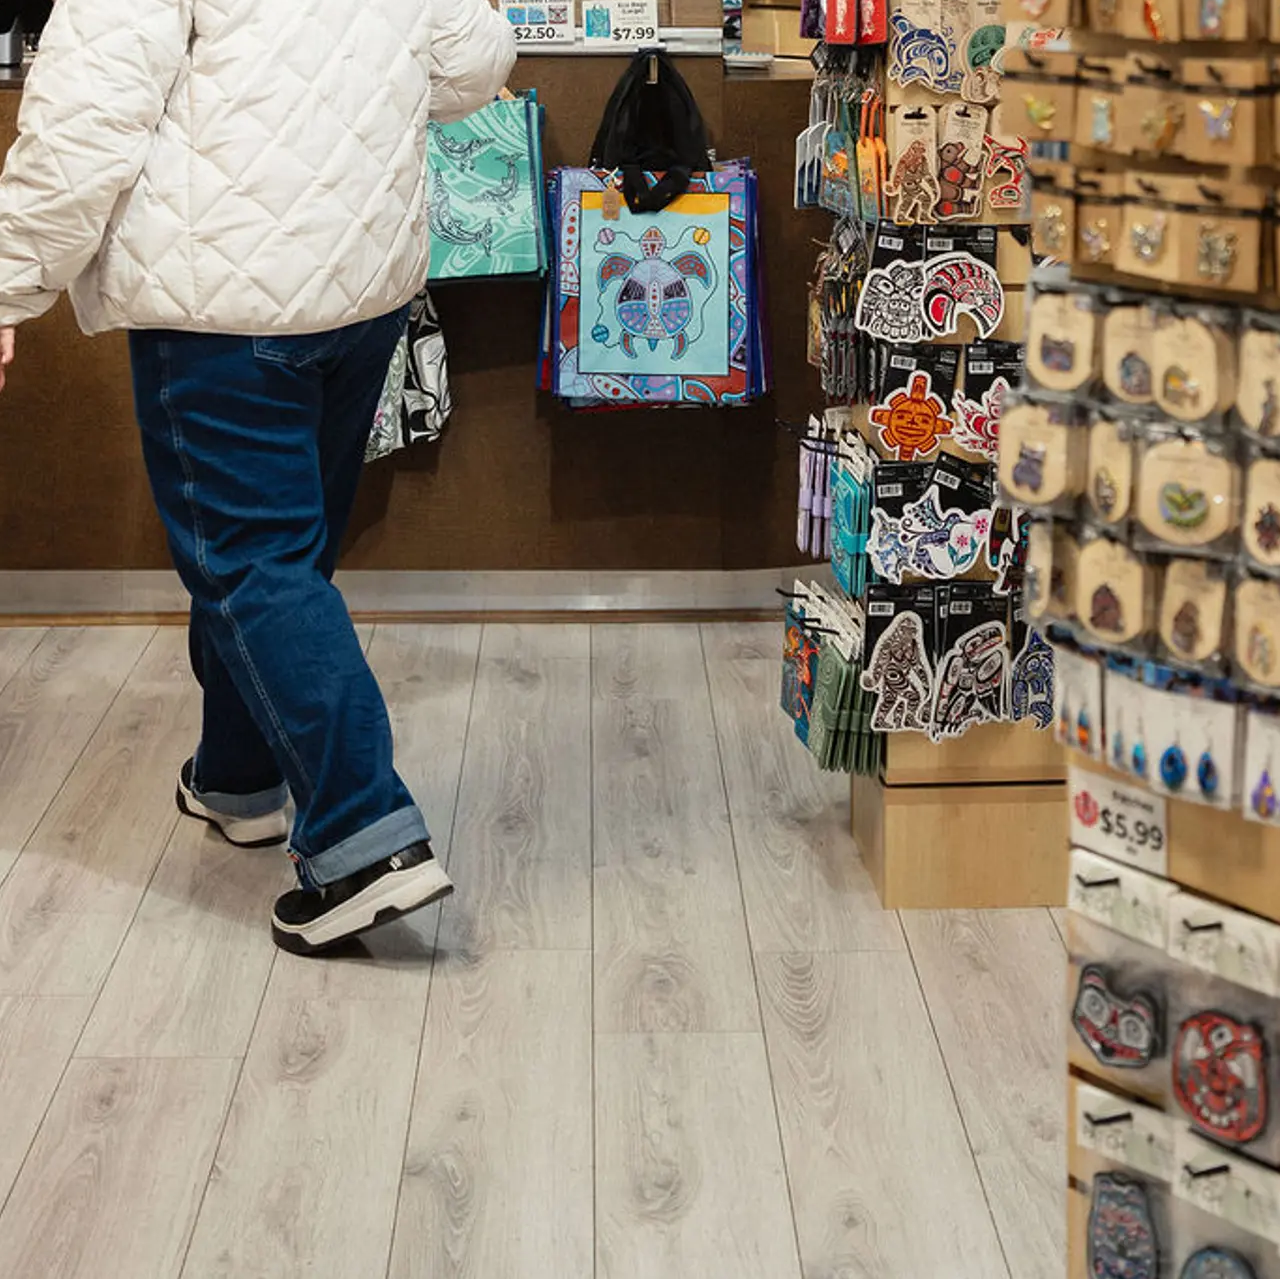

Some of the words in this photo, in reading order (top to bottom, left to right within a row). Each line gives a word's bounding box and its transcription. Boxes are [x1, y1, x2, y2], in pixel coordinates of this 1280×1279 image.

[513, 26, 556, 40] $2.50
[612, 27, 655, 41] $7.99
[1100, 805, 1164, 851] $5.99
